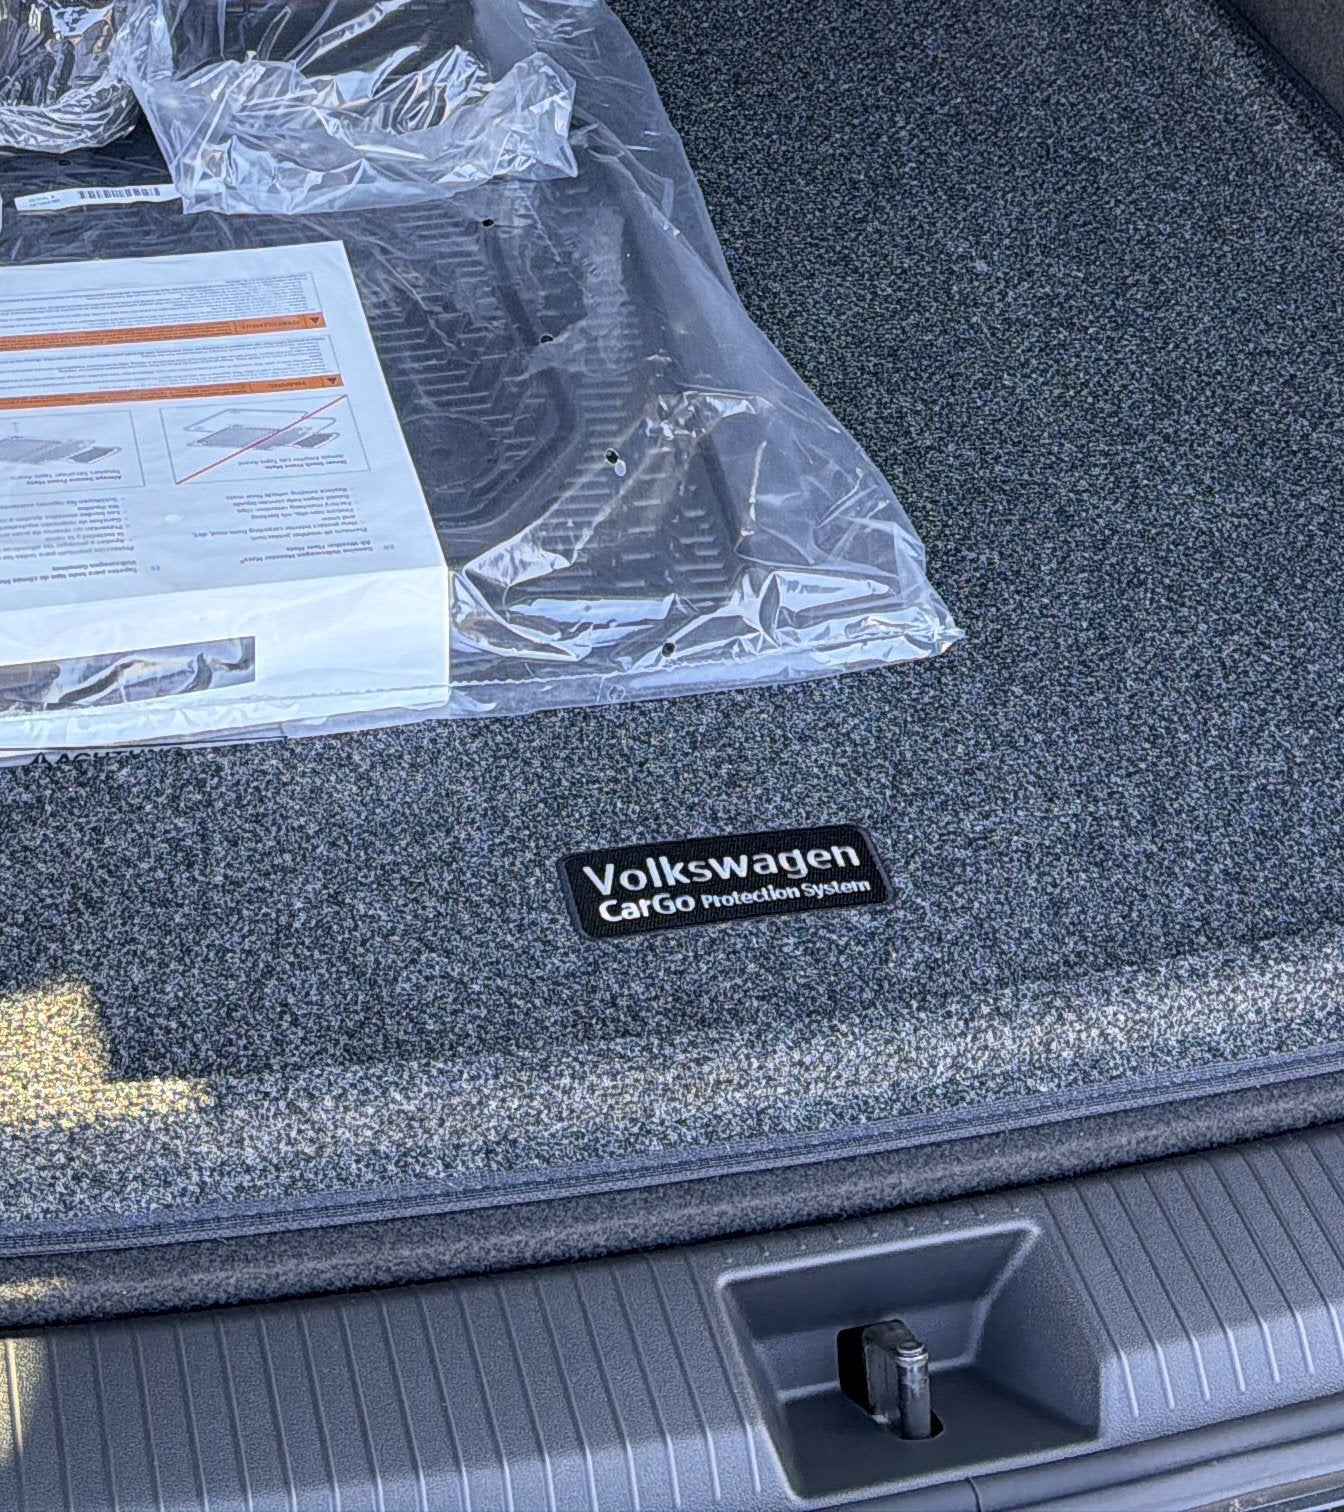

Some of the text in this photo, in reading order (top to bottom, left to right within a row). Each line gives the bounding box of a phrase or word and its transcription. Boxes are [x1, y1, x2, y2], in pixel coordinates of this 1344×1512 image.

[583, 845, 861, 896] Volkswagen
[598, 880, 871, 923] CarGo Protection System
